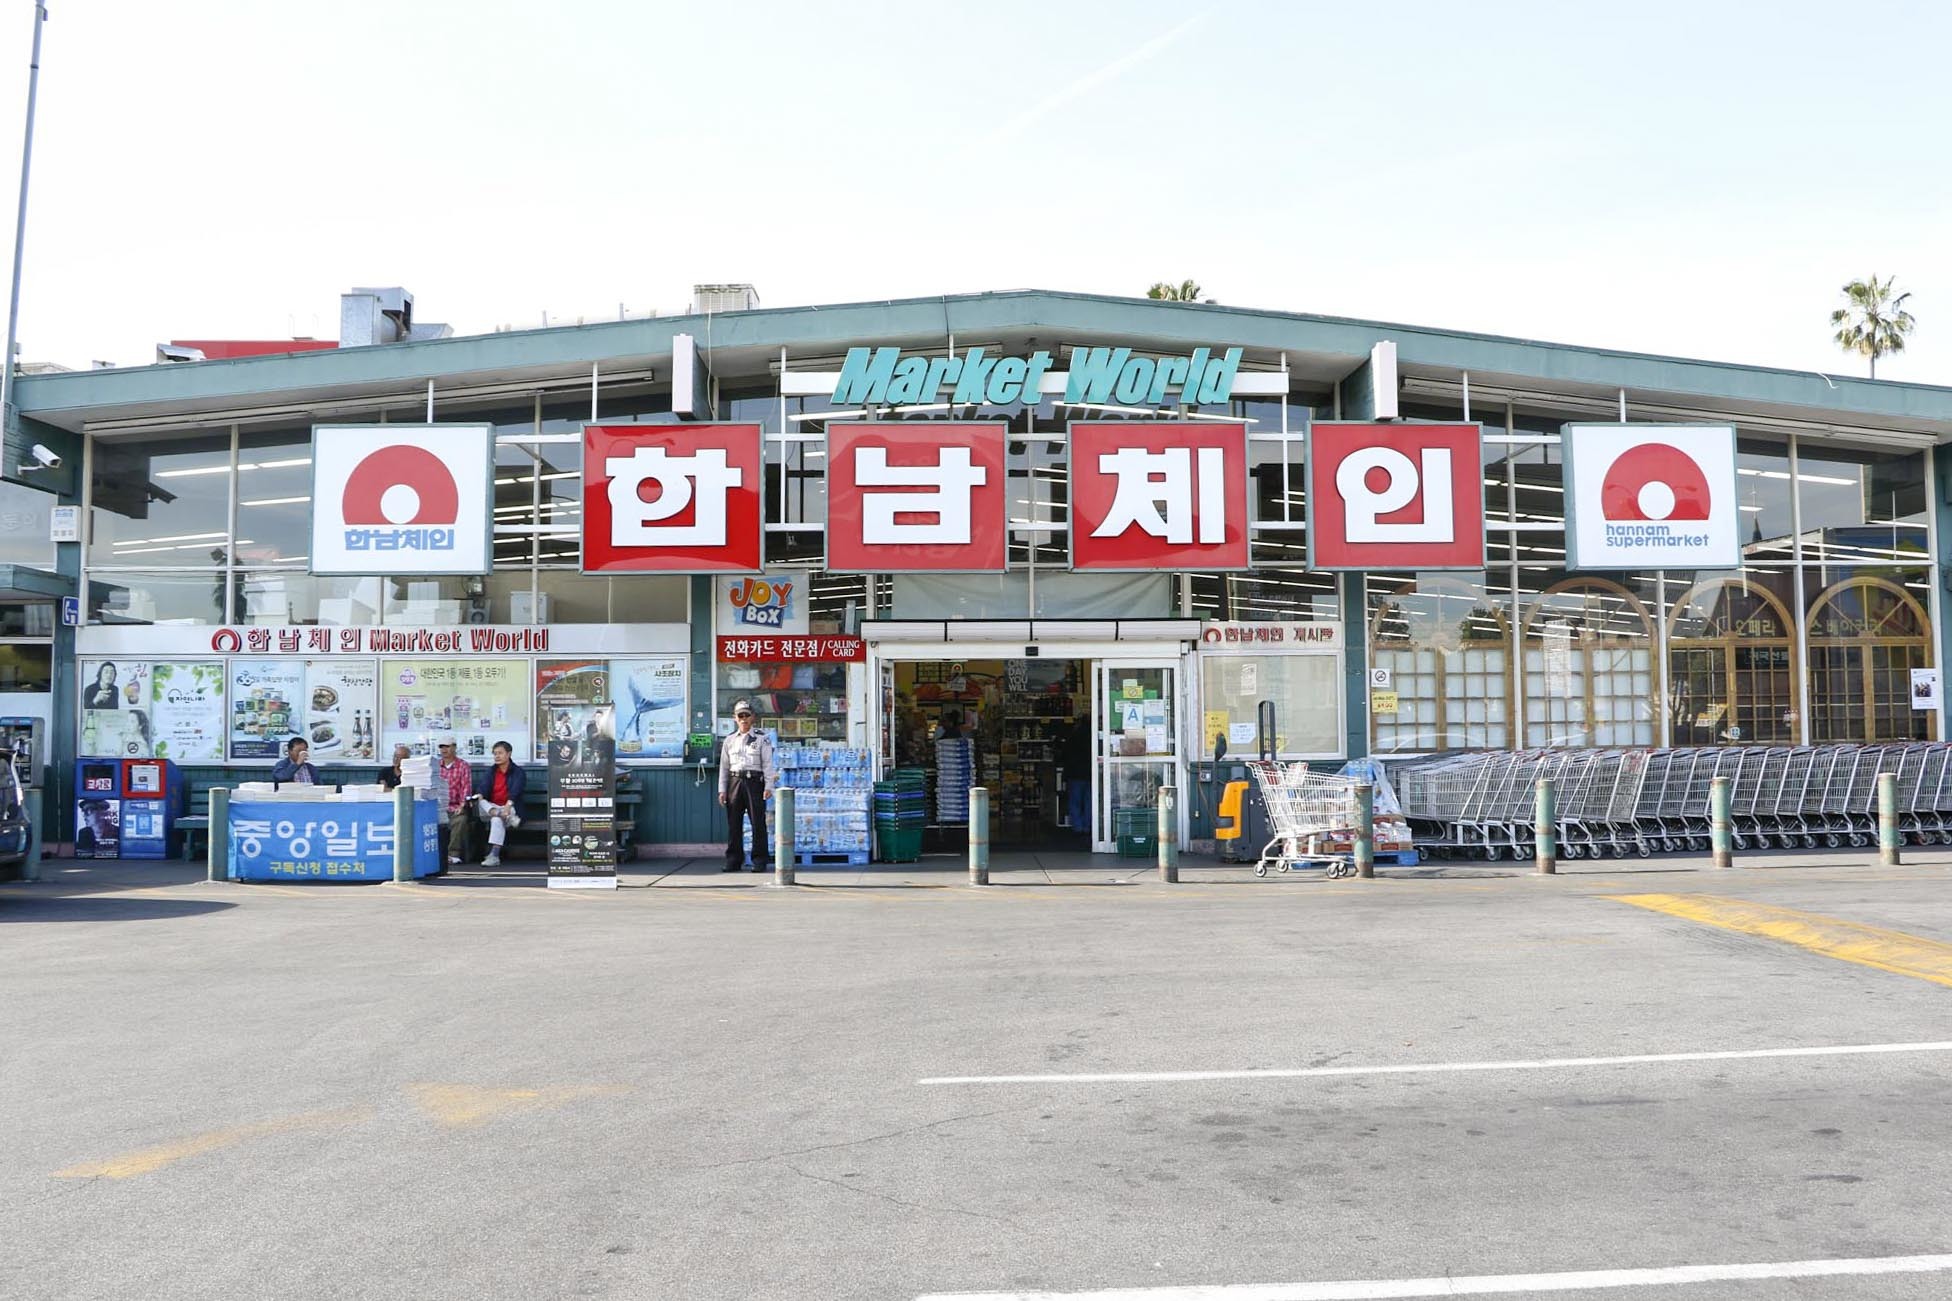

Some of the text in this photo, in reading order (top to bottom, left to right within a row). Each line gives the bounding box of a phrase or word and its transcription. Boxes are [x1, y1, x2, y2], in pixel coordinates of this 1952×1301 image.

[830, 347, 1243, 406] Market World
[1606, 523, 1671, 537] hannam
[344, 528, 455, 551] 한남체인
[1606, 534, 1710, 548] supermarket
[729, 577, 794, 608] JOY
[370, 628, 462, 652] Market
[471, 628, 550, 652] World
[1224, 627, 1334, 643] 한남체인 게시판
[724, 640, 775, 658] 전화카드
[827, 640, 860, 649] CALLING
[832, 648, 855, 657] CARD
[1008, 659, 1025, 668] ONE
[1008, 668, 1026, 676] DAY
[1009, 676, 1028, 684] YOU
[1008, 684, 1028, 692] WILL
[1127, 708, 1139, 721] A
[233, 819, 395, 858] 중앙일보
[269, 861, 366, 875] 구독신청 접수처
